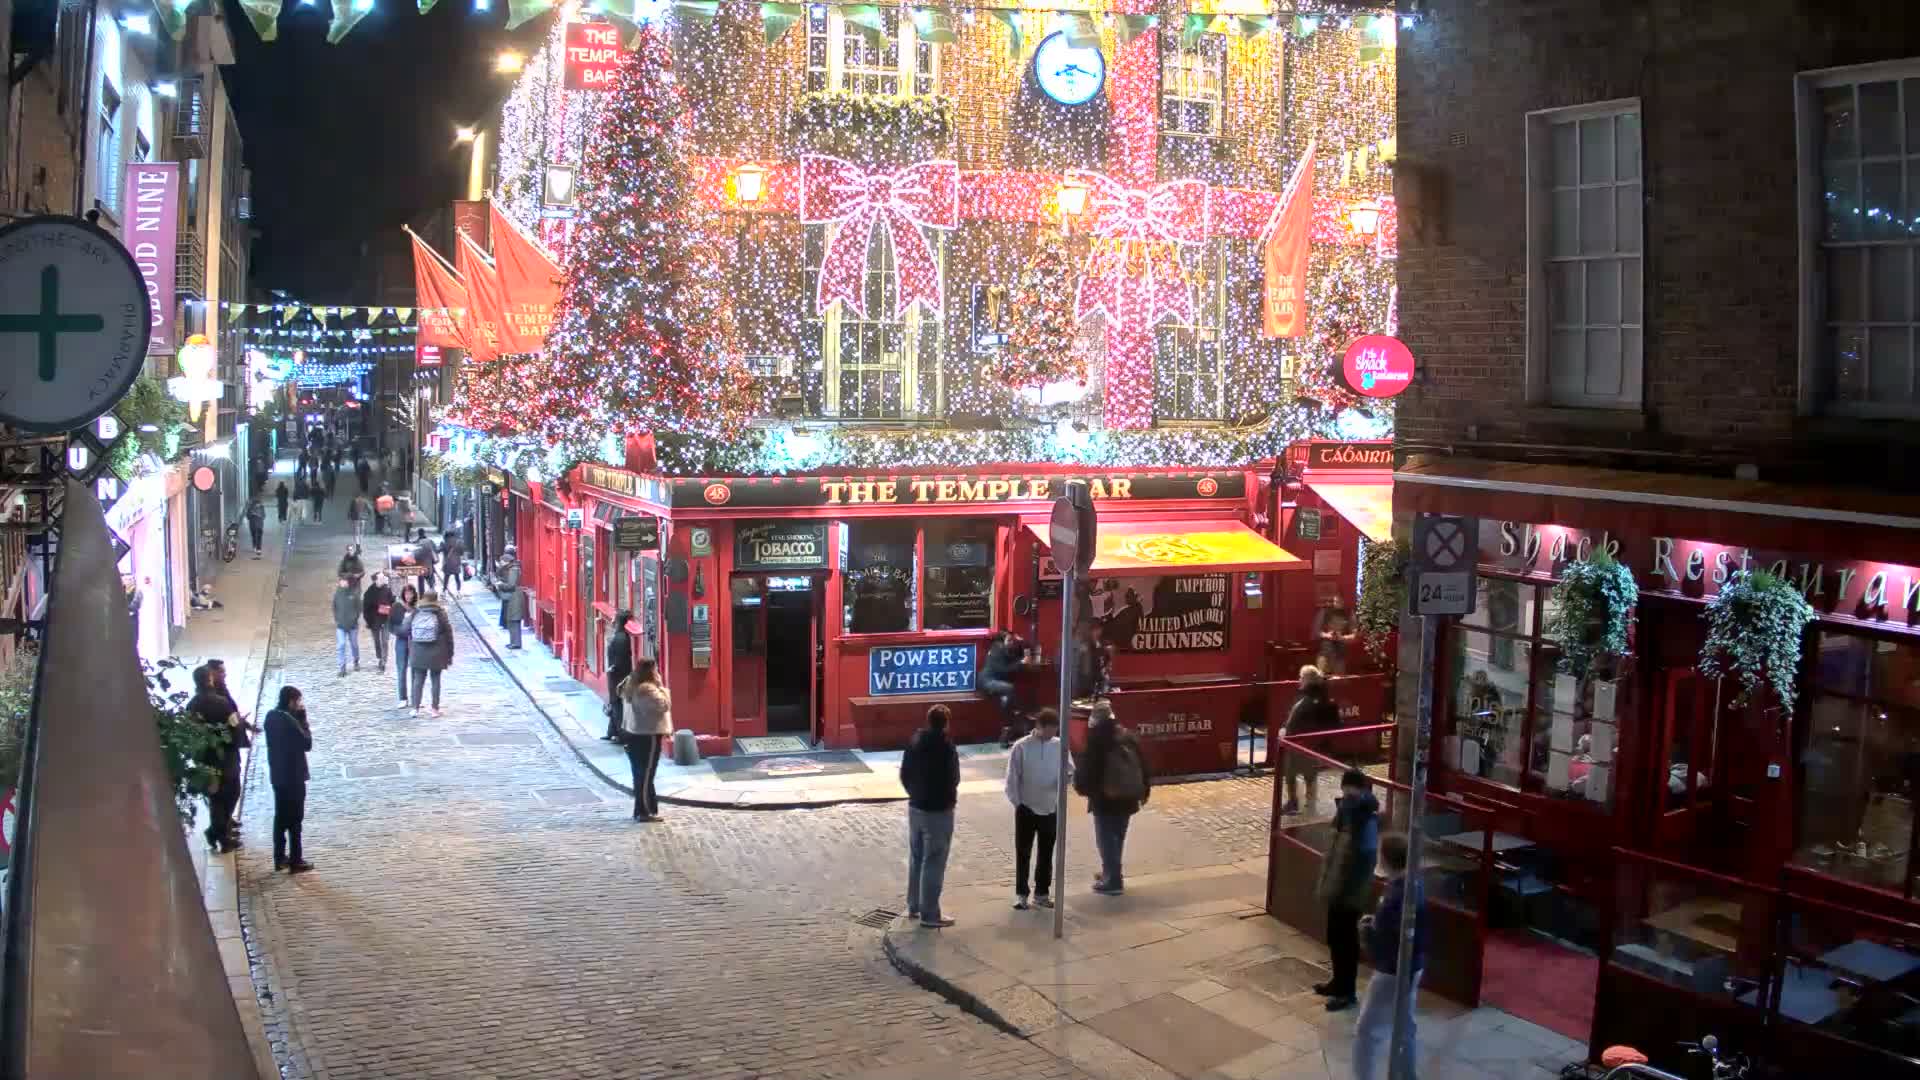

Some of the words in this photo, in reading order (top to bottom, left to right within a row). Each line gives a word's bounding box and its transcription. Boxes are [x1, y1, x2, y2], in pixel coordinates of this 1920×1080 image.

[583, 29, 617, 45] THE
[136, 171, 169, 232] NINE
[521, 303, 547, 313] THE
[520, 325, 551, 336] BAR
[89, 302, 137, 400] PHARMACY
[1355, 348, 1388, 374] Shack
[709, 486, 726, 500] 48
[822, 481, 898, 504] THE
[911, 479, 1050, 503] TEMPLE
[750, 538, 816, 562] TOBACCO
[1499, 520, 1621, 565] Shack
[1175, 578, 1226, 593] EMPEROR
[1420, 583, 1443, 602] 24
[1211, 593, 1225, 606] OF
[1137, 616, 1181, 633] MALTED
[1131, 631, 1225, 650] GUINNESS
[880, 647, 969, 668] POWER'S
[872, 670, 974, 690] WHISKEY
[1187, 720, 1213, 732] BAR
